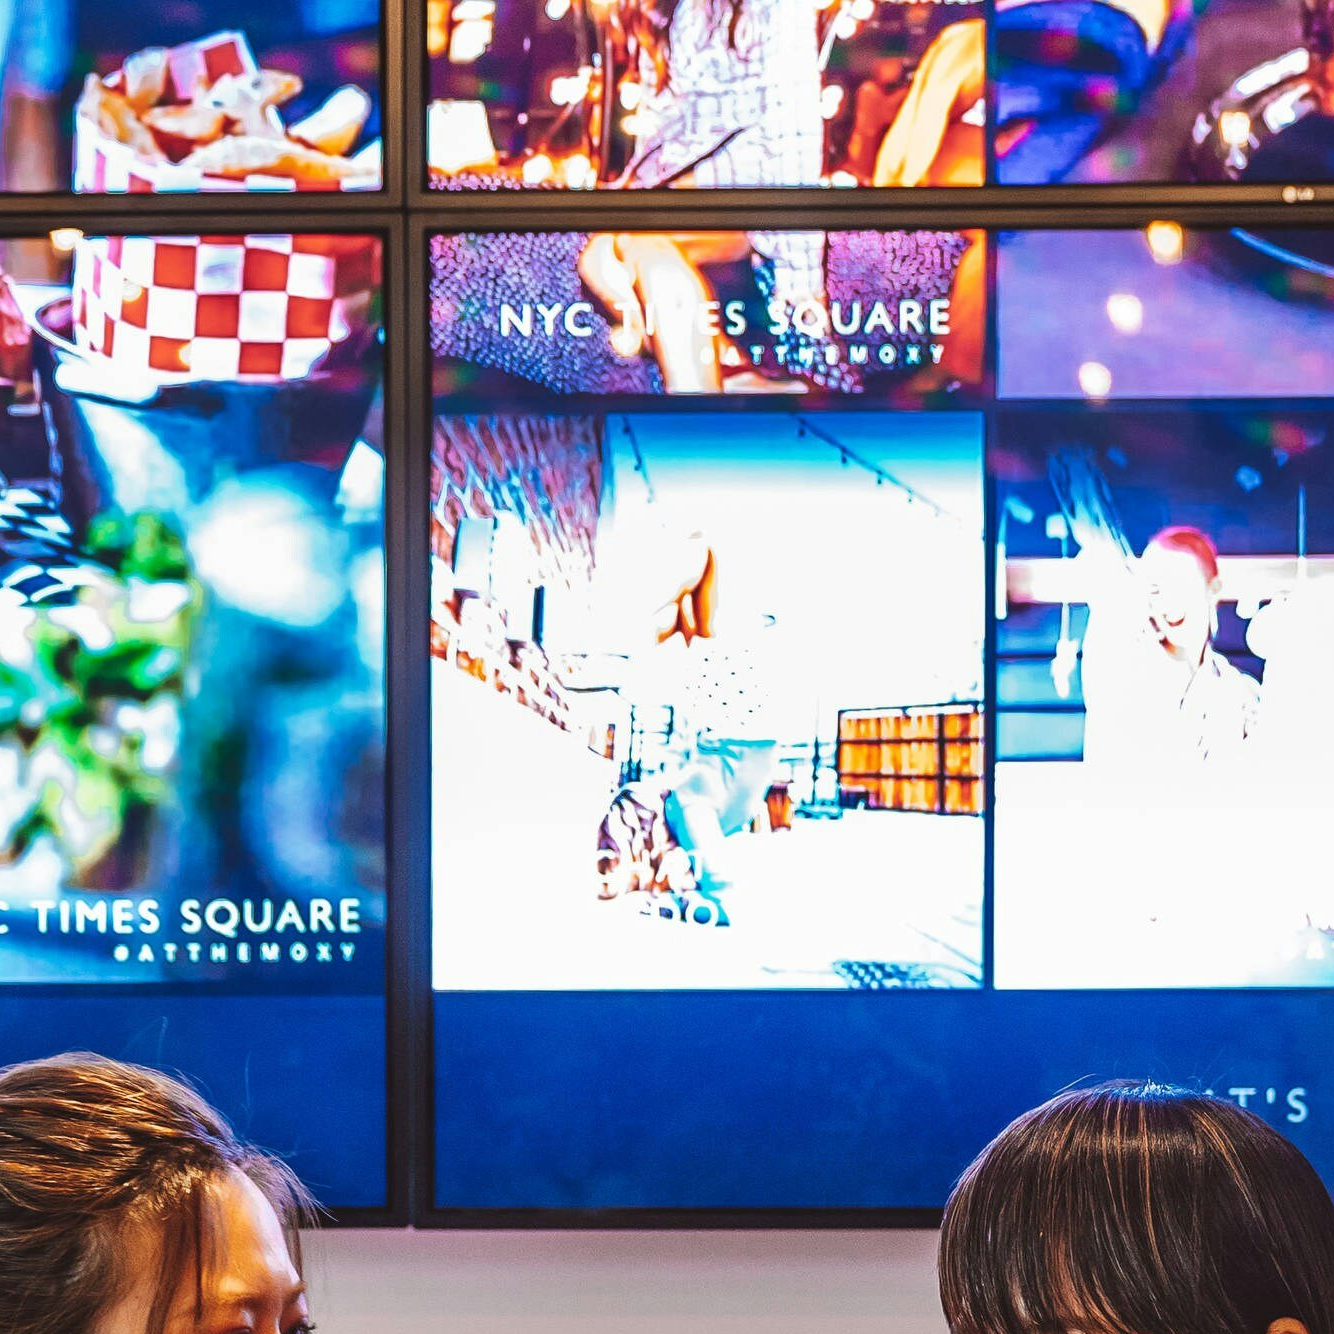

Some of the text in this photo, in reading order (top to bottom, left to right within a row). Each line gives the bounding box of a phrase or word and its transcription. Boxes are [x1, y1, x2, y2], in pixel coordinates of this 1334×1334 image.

[499, 300, 951, 338] NYC TIES SQUARE
[29, 898, 160, 935] TIMES
[179, 897, 362, 938] SQUARE
